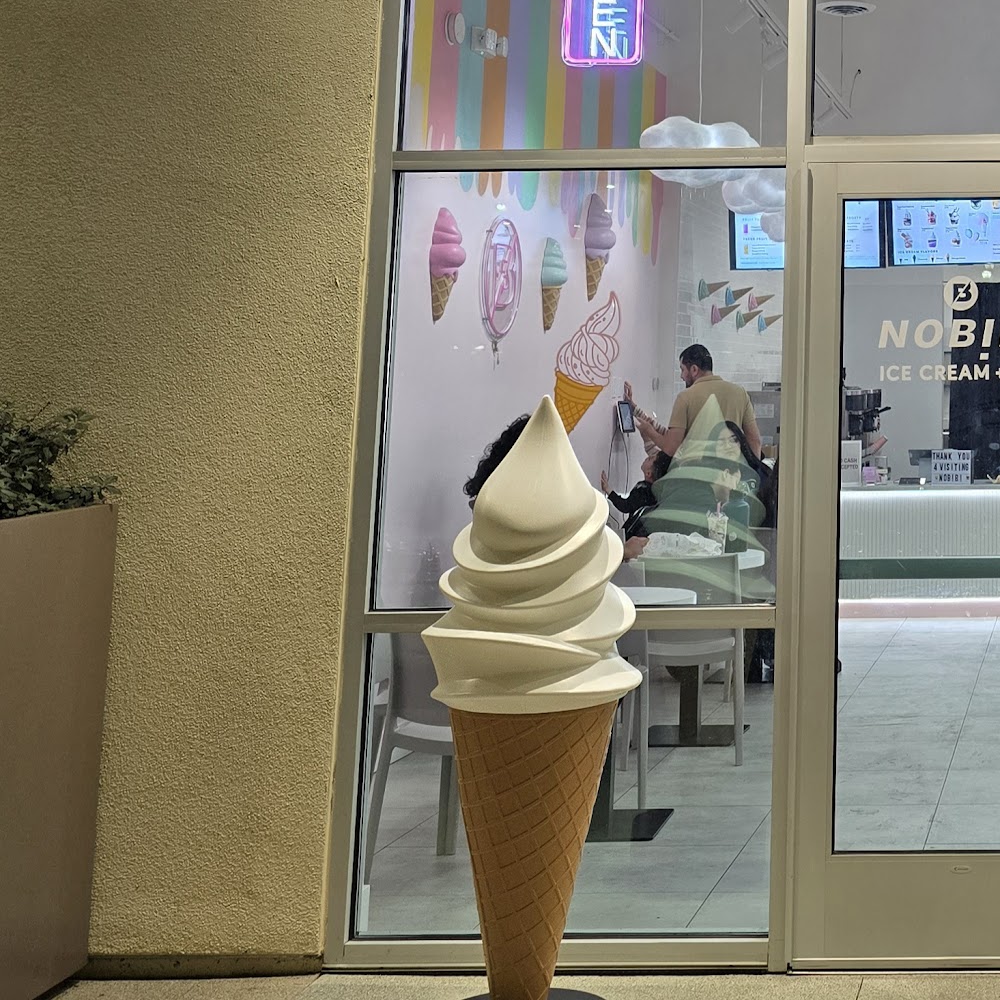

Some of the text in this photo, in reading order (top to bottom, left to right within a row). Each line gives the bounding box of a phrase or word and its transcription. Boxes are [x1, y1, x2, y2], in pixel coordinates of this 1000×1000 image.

[879, 365, 911, 382] ICE
[919, 364, 990, 381] CREAM
[932, 452, 970, 460] THANK YOU
[940, 463, 969, 471] VISITING
